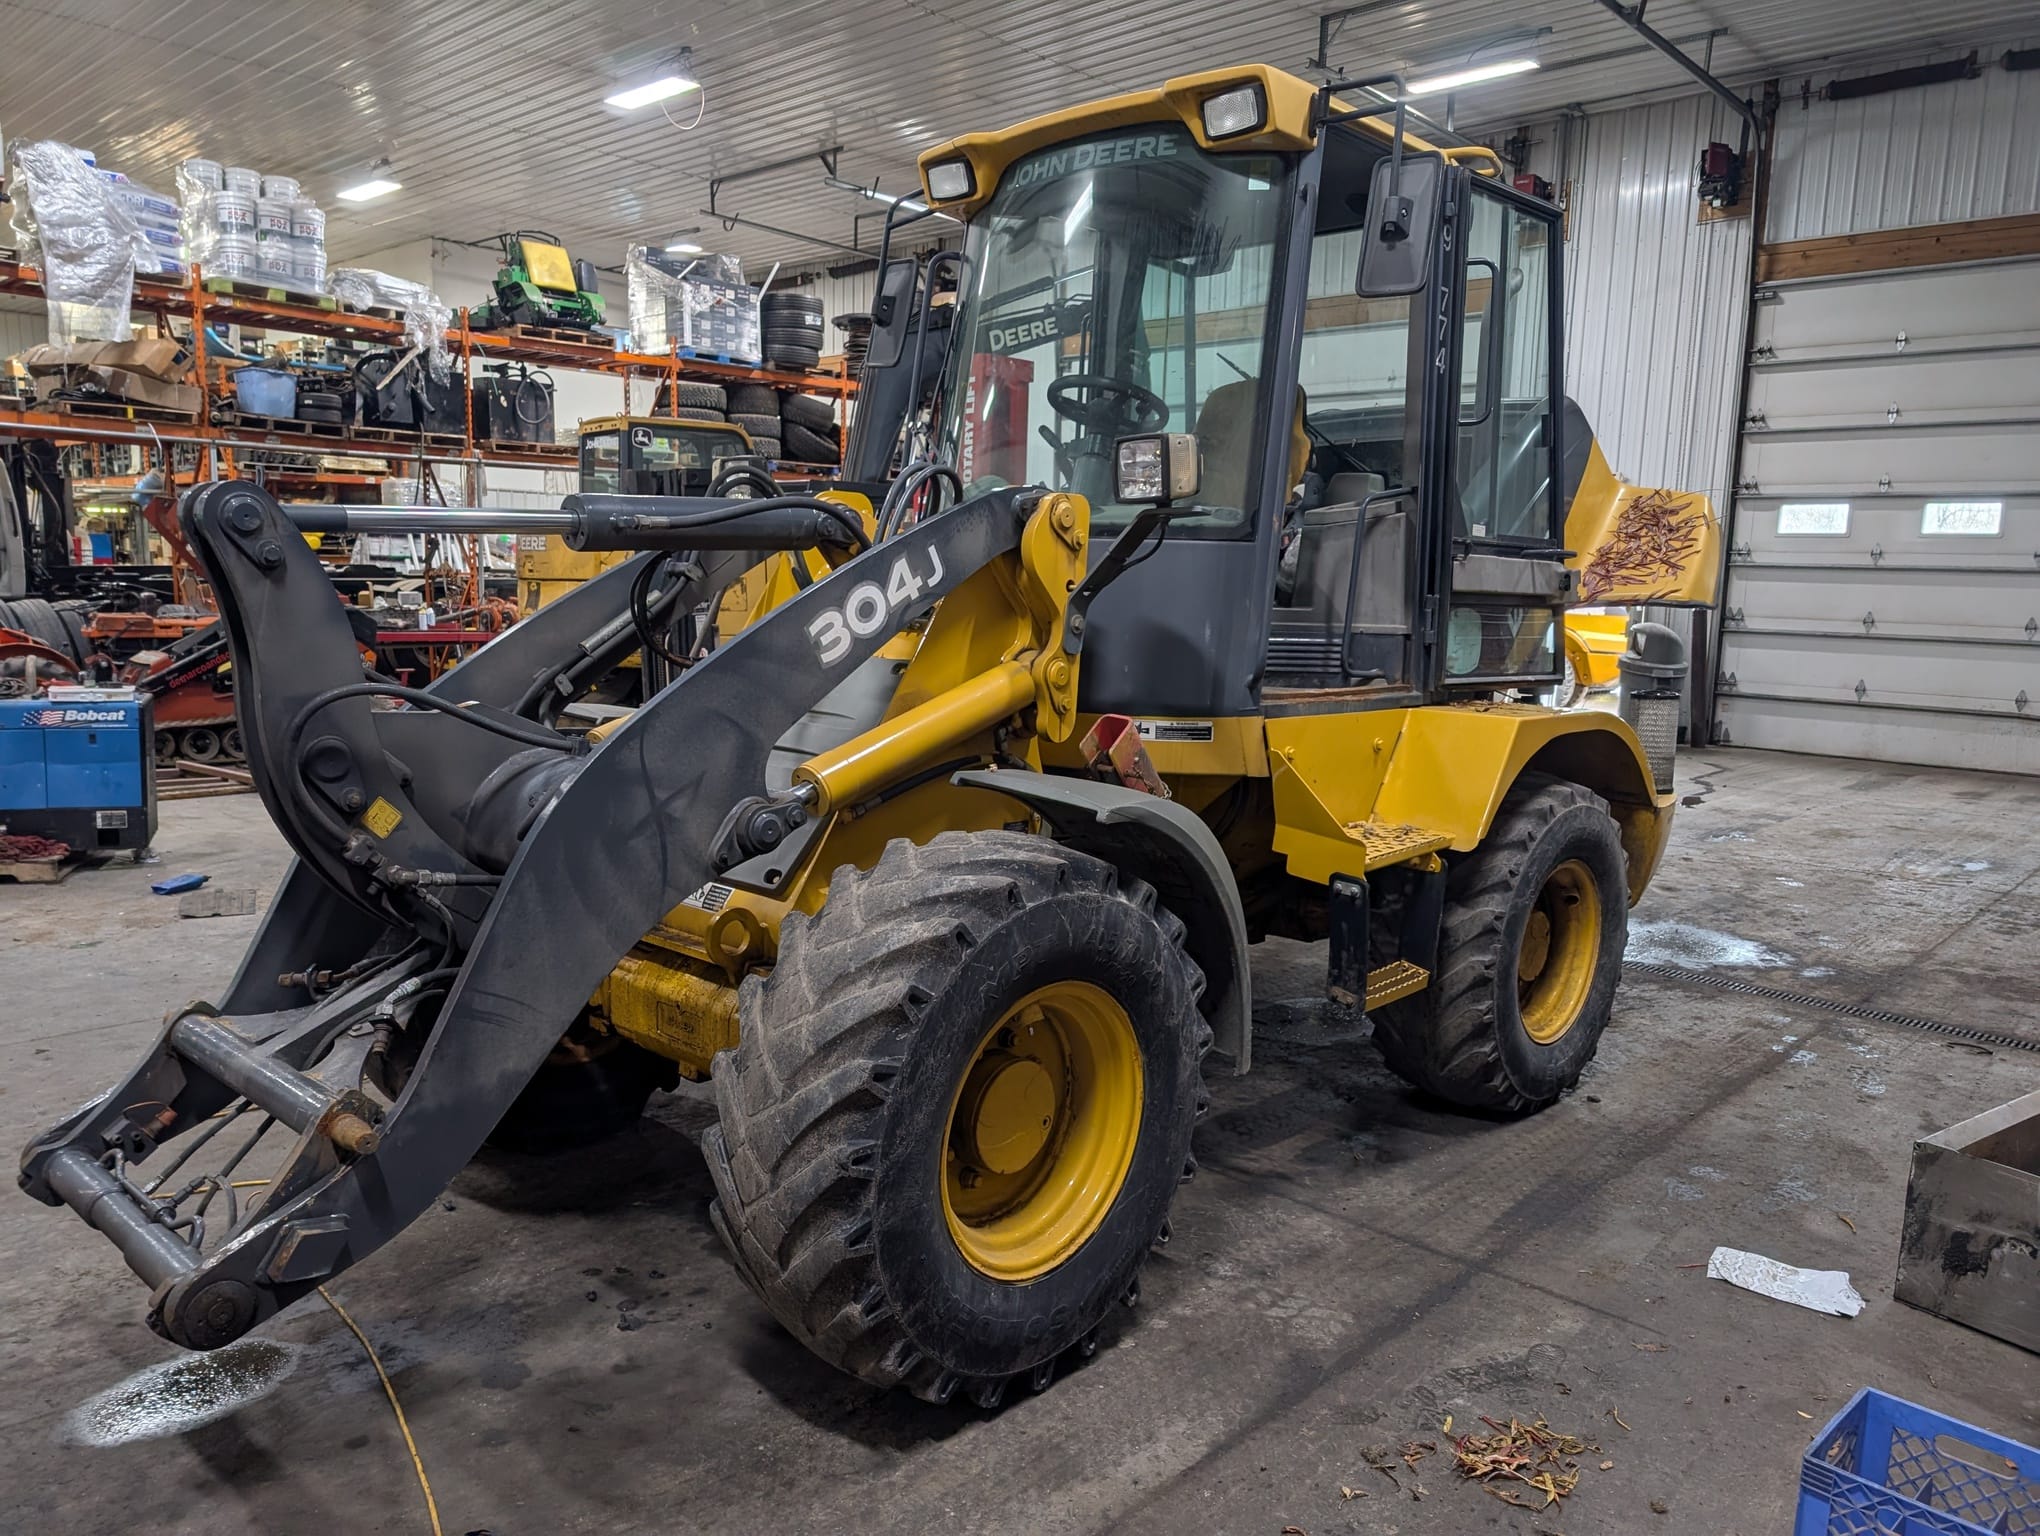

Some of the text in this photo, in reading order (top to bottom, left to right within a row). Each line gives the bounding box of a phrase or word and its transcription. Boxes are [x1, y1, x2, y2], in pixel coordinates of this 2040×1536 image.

[1007, 134, 1176, 191] JOHN DEERE
[989, 317, 1058, 352] DEERE
[518, 537, 546, 551] EERE
[808, 543, 944, 665] 304J
[64, 710, 125, 721] Bobcat
